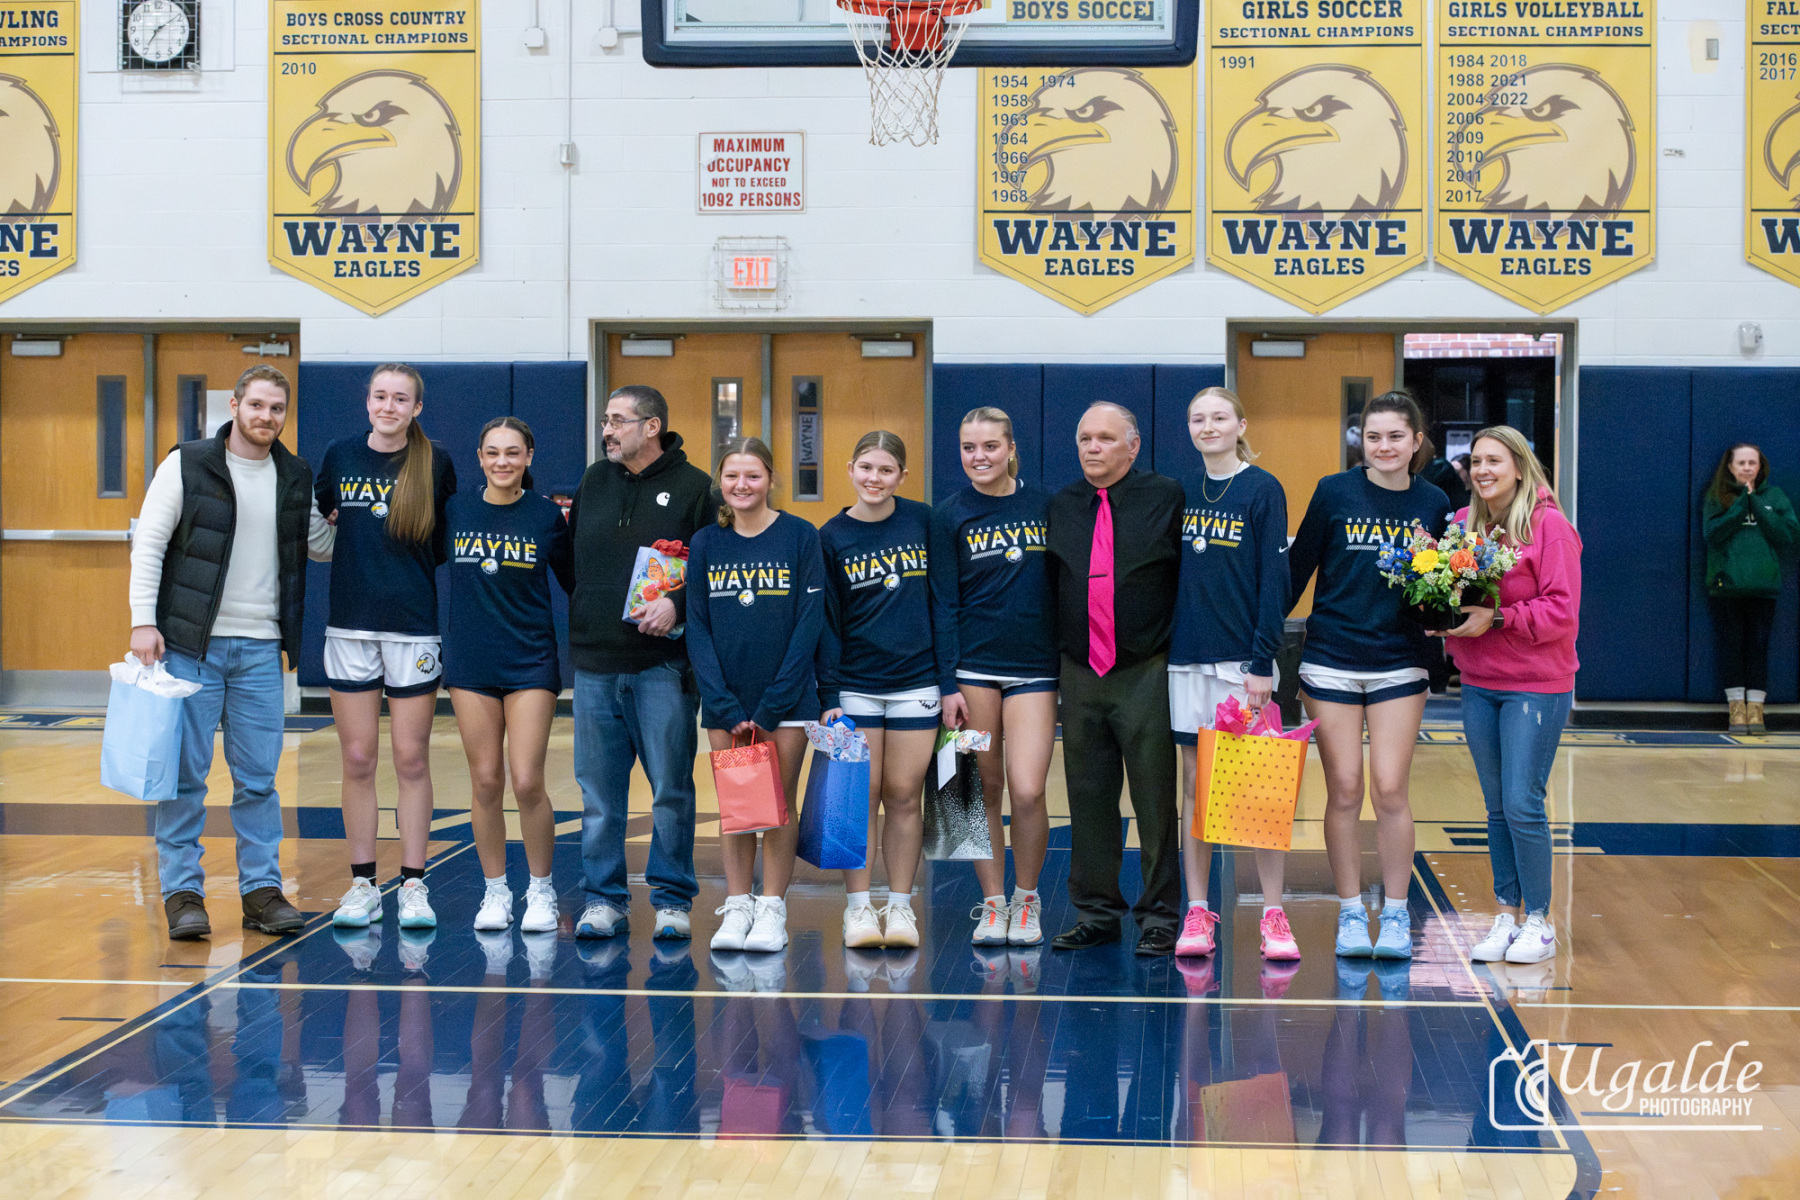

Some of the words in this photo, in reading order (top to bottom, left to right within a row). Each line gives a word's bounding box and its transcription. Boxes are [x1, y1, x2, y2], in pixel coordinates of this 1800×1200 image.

[1012, 1, 1069, 19] BOYS
[1242, 0, 1309, 19] GIRLS
[1317, 0, 1403, 19] SOCCER
[1448, 1, 1507, 18] GIRLS
[1514, 1, 1644, 18] VOLLEYBALL
[286, 13, 327, 27] BOYS
[333, 12, 384, 26] CROSS
[390, 10, 466, 26] COUNTRY
[1219, 27, 1311, 39] SECTIONAL
[1316, 26, 1414, 38] CHAMPIONS
[1448, 26, 1540, 37] SECTIONAL
[1545, 26, 1644, 37] CHAMPIONS
[282, 34, 369, 46] SECTIONAL
[374, 32, 468, 45] CHAMPIONS
[1219, 56, 1255, 69] 1991
[1448, 55, 1485, 67] 1984
[1490, 54, 1527, 67] 2018
[1759, 53, 1797, 66] 2016
[281, 62, 317, 75] 2010
[1759, 67, 1796, 80] 2017
[992, 75, 1028, 88] 1954
[1039, 75, 1076, 88] 1974
[1447, 74, 1484, 87] 1988
[1490, 74, 1526, 87] 2021
[992, 94, 1028, 107] 1958
[1447, 93, 1484, 106] 2004
[1490, 93, 1528, 106] 2022
[992, 113, 1028, 126] 1963
[1447, 112, 1484, 125] 2006
[992, 132, 1028, 145] 1964
[1447, 131, 1484, 144] 2009
[713, 138, 785, 152] MAXIMUM
[992, 151, 1028, 164] 1966
[1446, 150, 1484, 163] 2010
[707, 157, 791, 172] OCCUPANCY
[712, 177, 730, 187] NOT
[734, 177, 746, 187] TO
[750, 177, 787, 187] EXCEED
[992, 170, 1028, 183] 1967
[1446, 169, 1481, 182] 2011
[702, 192, 734, 207] 1092
[740, 192, 801, 207] PERSONS
[992, 189, 1028, 202] 1968
[1445, 189, 1482, 202] 2017
[283, 221, 460, 259] WAYNE
[993, 219, 1176, 257] WAYNE
[1222, 219, 1407, 256] WAYNE
[1448, 218, 1634, 257] WAYNE
[333, 260, 421, 278] EAGLES
[733, 257, 772, 286] EXIT
[1044, 258, 1135, 276] EAGLES
[1274, 257, 1365, 275] EAGLES
[1500, 257, 1592, 275] EAGLES
[801, 415, 813, 462] WAYNE
[456, 531, 536, 544] BASKETBALL
[454, 537, 537, 563] WAYNE
[844, 543, 926, 565] BASKETBALL
[710, 561, 789, 571] BASKETBALL
[844, 550, 927, 583] WAYNE
[707, 568, 791, 591] WAYNE
